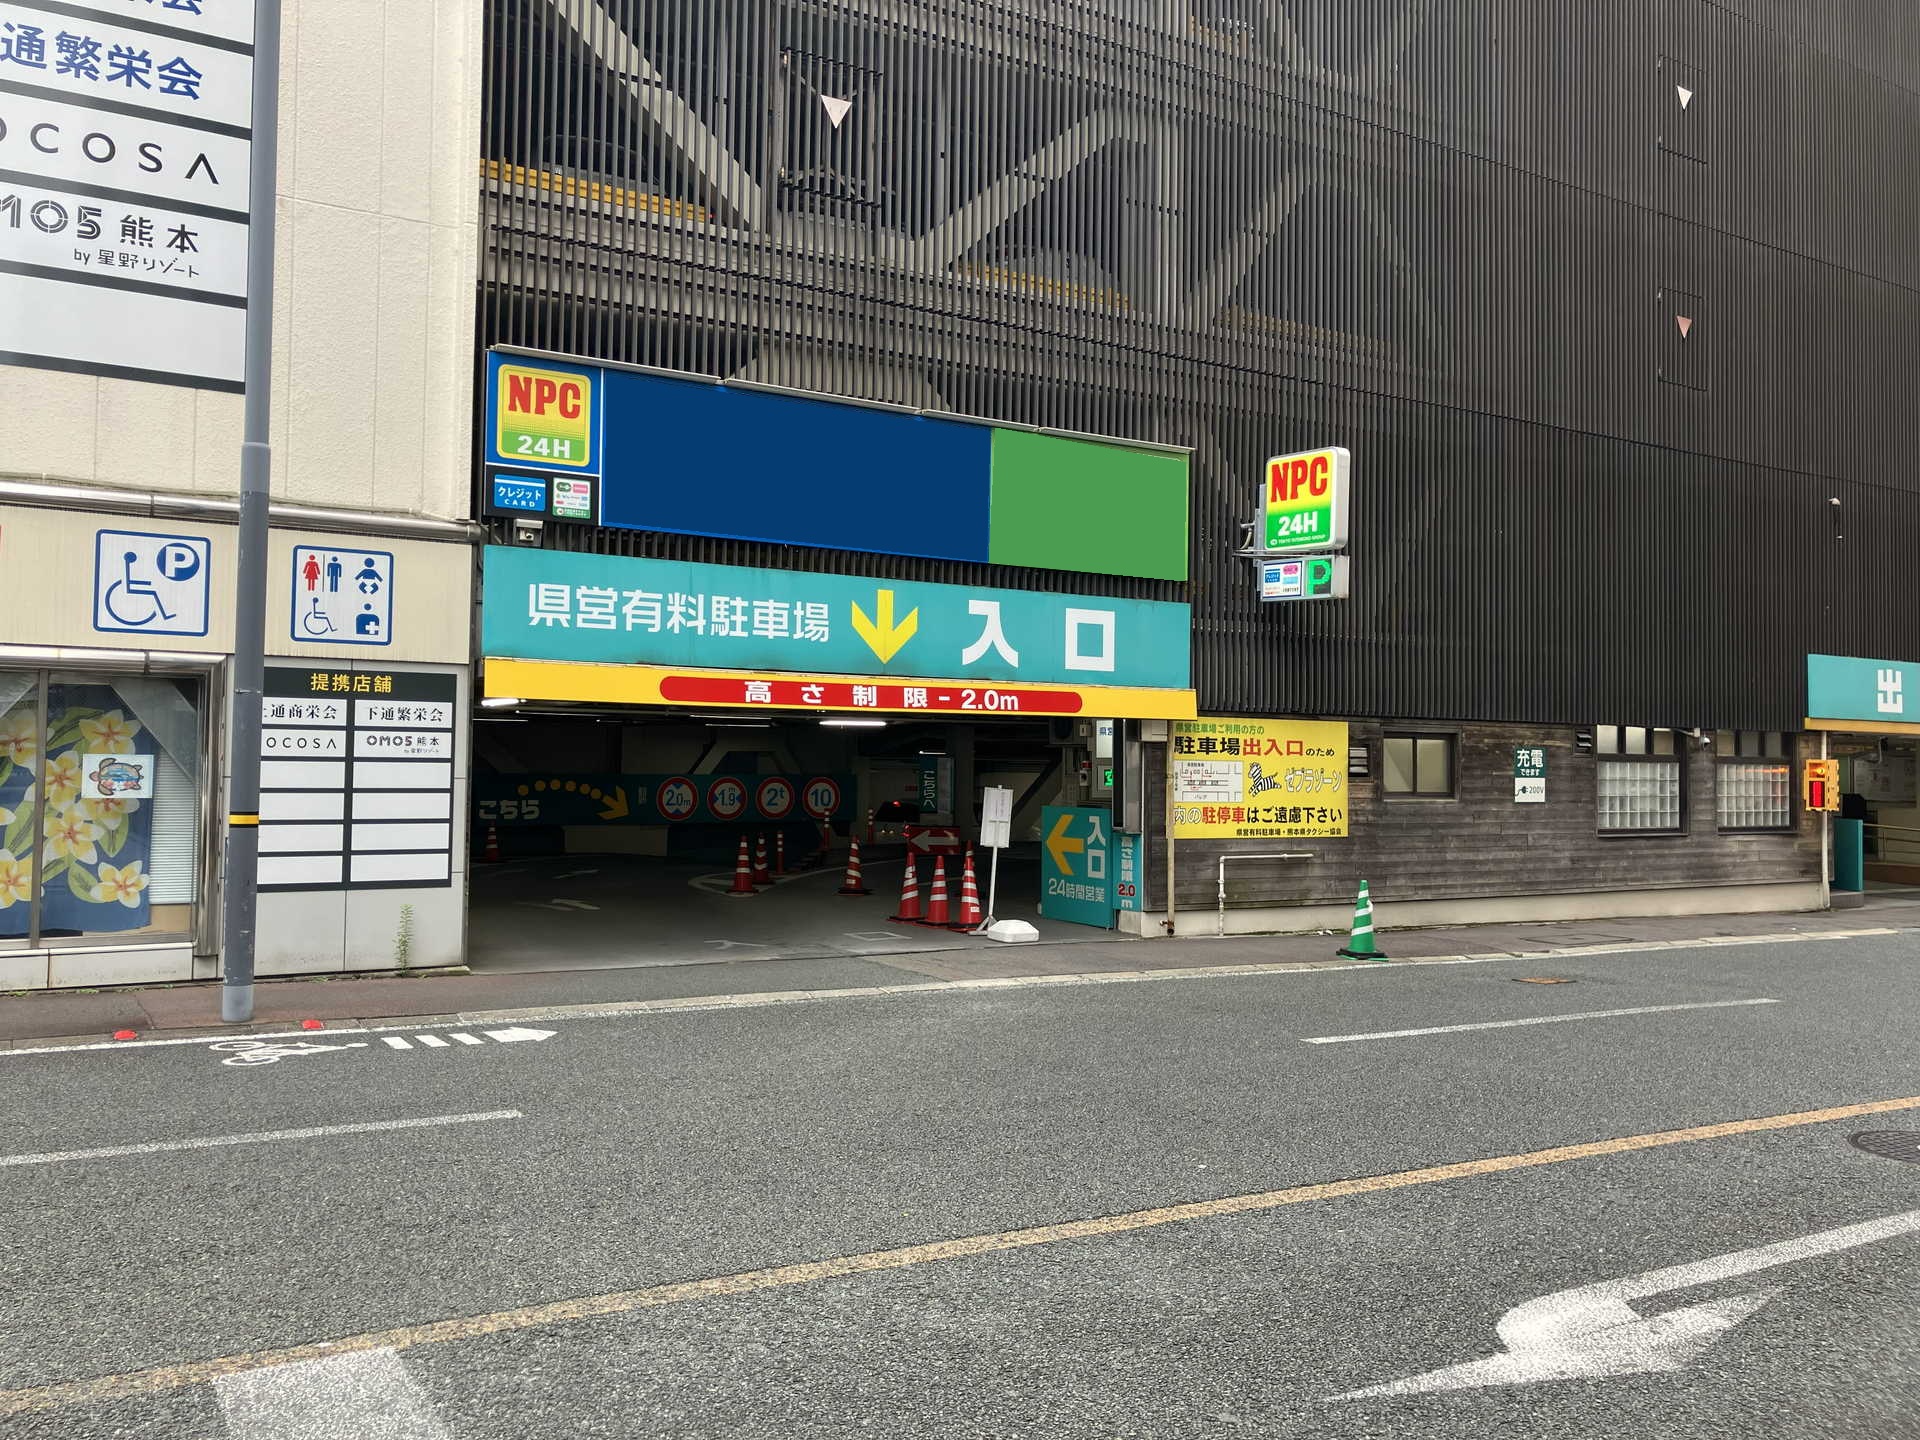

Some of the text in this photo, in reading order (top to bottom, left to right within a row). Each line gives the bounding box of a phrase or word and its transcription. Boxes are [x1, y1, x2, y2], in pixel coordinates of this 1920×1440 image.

[119, 213, 200, 254] 熊本
[73, 248, 200, 278] by 星野リゾート
[507, 374, 582, 420] NPC
[516, 434, 572, 460] 24H
[1270, 455, 1329, 503] NPC
[497, 485, 543, 502] クレジット
[504, 498, 536, 508] CARD
[1277, 510, 1319, 537] 24H
[528, 583, 1116, 673] 県営有料駐車場 入口
[310, 672, 393, 694] 提携店舗
[1877, 668, 1903, 714] 出
[264, 703, 338, 720] 通商栄会
[367, 705, 444, 723] 下通繁栄会
[416, 736, 440, 748] 熊本
[1517, 748, 1544, 769] 充電
[1285, 767, 1343, 793] ゼブラゾーン
[1529, 785, 1545, 794] 200V
[810, 788, 832, 808] 10
[1086, 815, 1106, 880] 入口
[1048, 877, 1105, 903] 24時間営業
